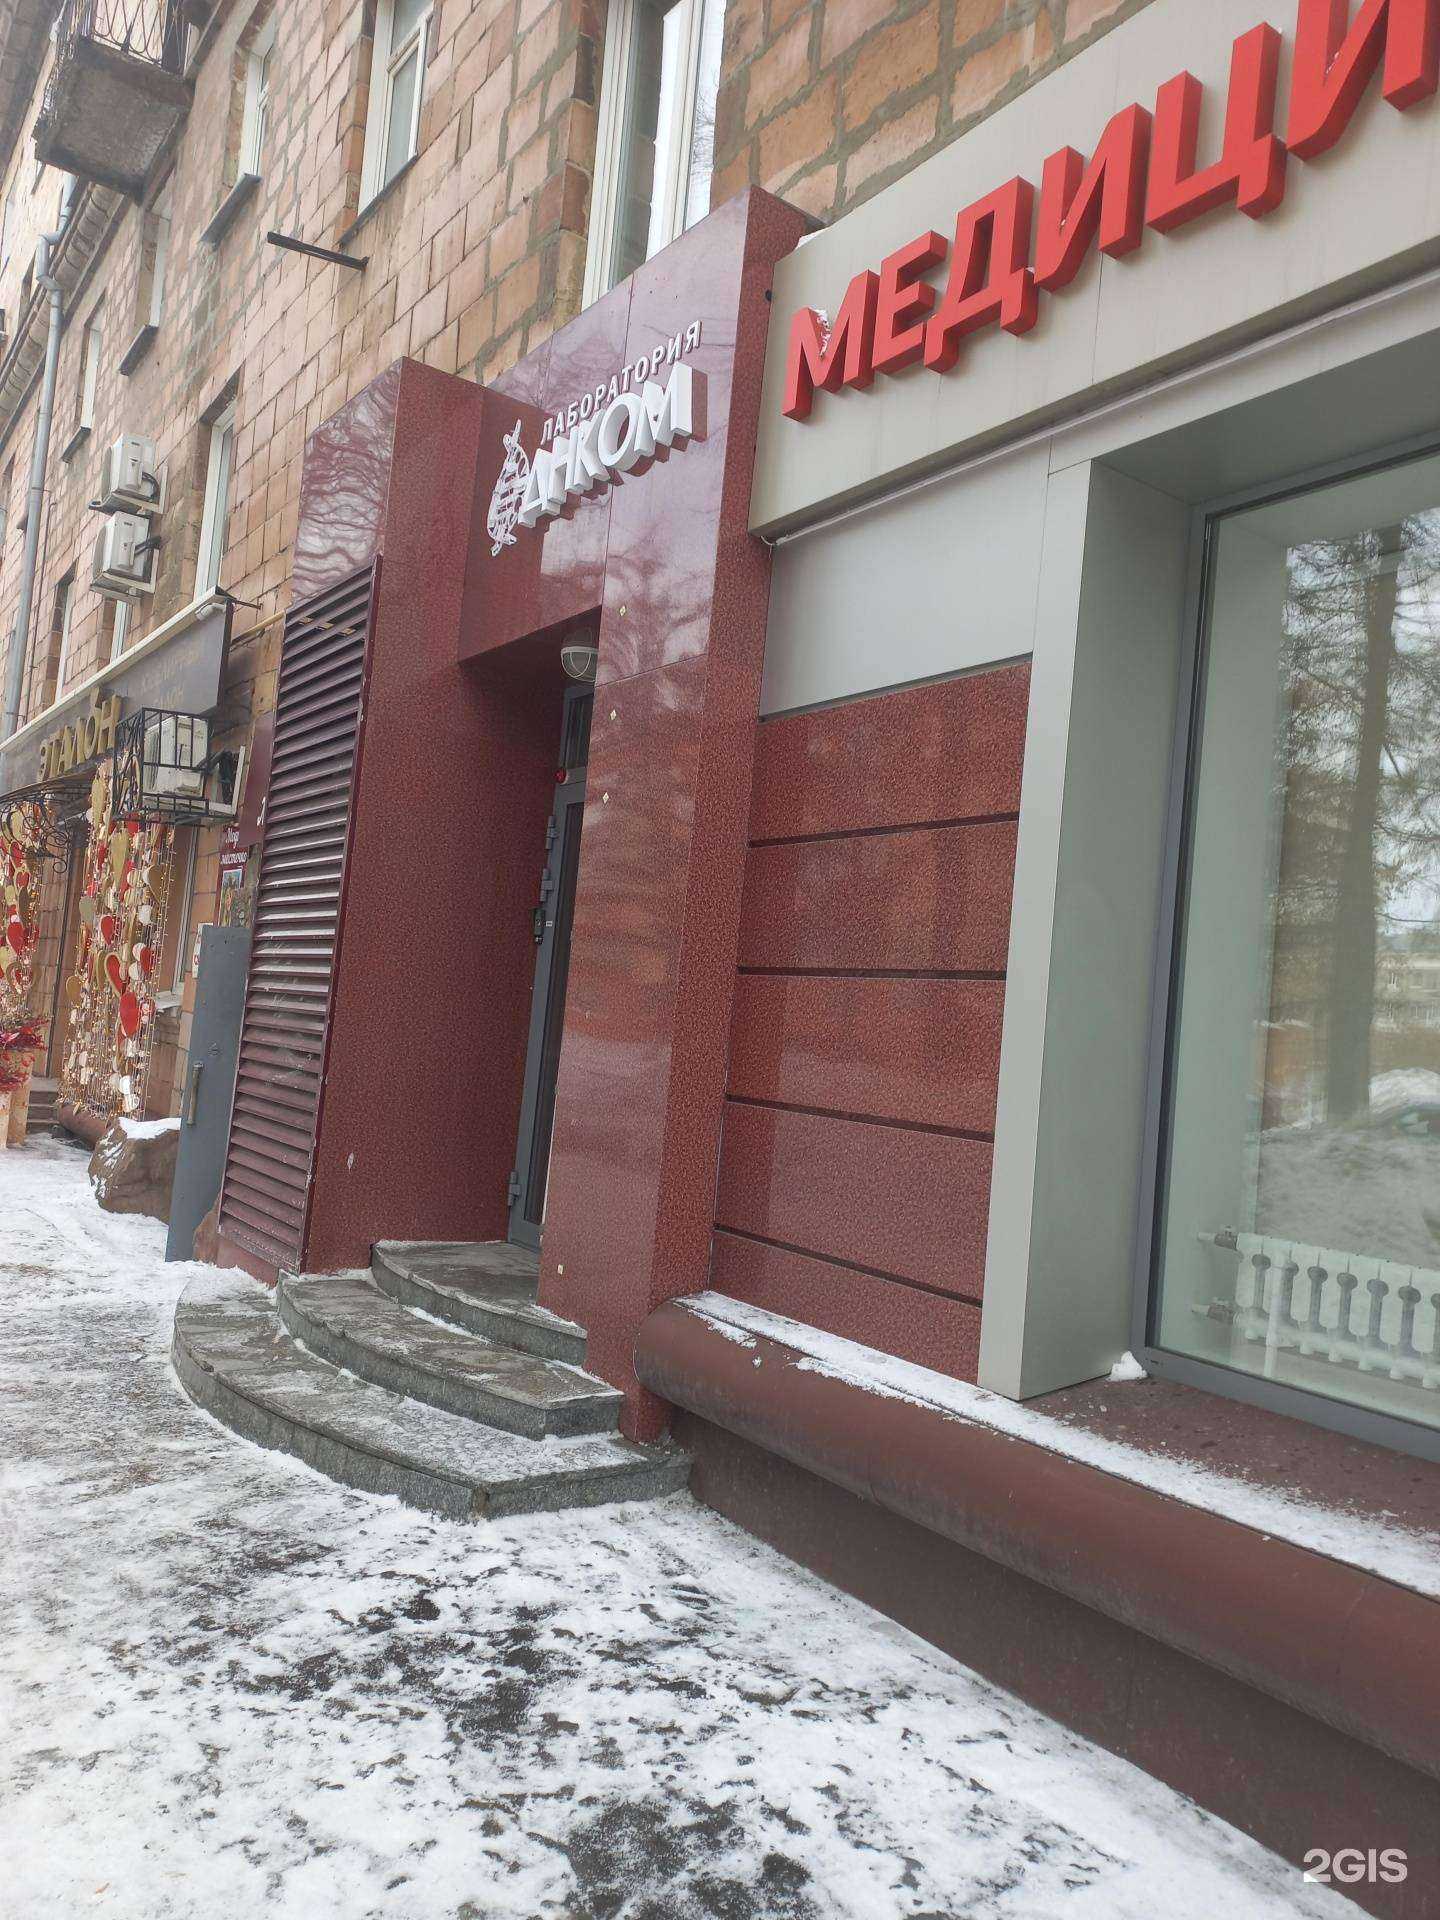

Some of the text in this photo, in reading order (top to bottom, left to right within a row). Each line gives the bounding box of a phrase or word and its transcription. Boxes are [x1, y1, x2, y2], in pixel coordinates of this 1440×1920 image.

[782, 0, 1440, 422] МЕДИЦИ
[518, 361, 693, 528] ДНКОМ
[541, 320, 701, 445] ЛАБОРАТОРИЯ
